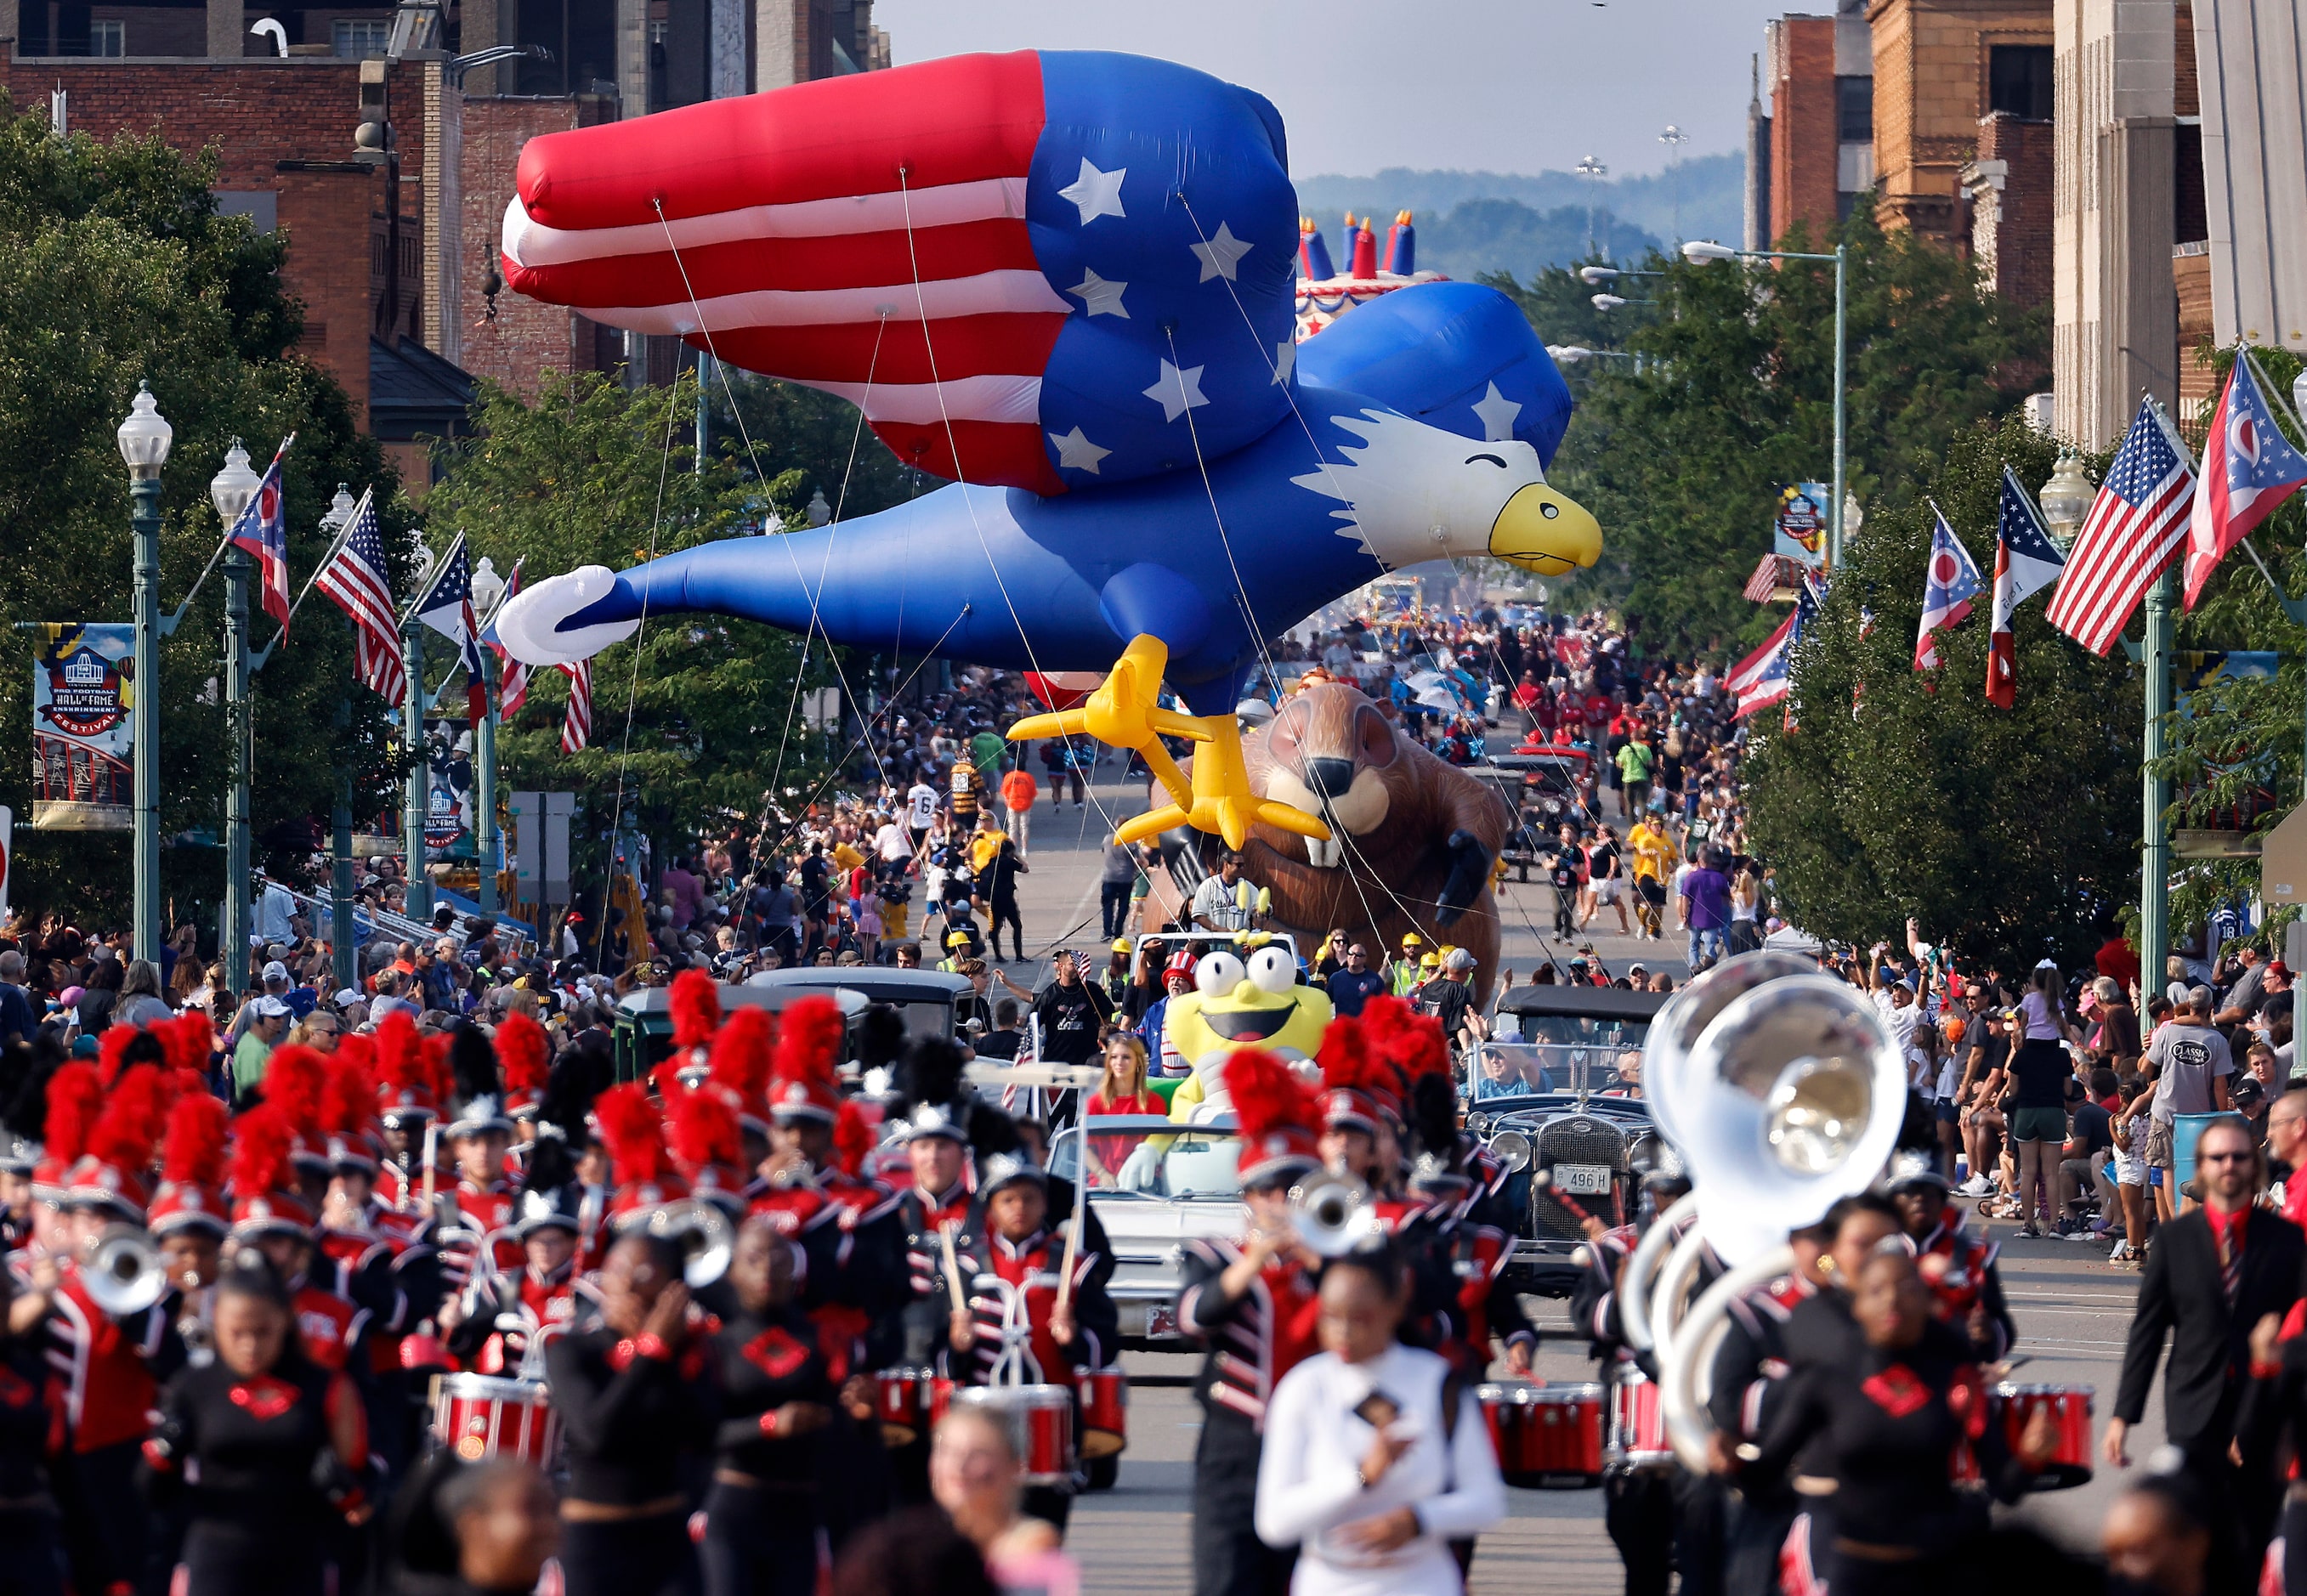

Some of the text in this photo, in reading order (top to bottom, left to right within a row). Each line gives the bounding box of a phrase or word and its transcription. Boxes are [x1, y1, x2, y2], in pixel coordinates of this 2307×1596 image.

[56, 694, 82, 705] HALL
[88, 694, 114, 705] FAME
[54, 713, 116, 733] FESTIVAL
[921, 796, 932, 814] 6
[2222, 925, 2235, 939] 18
[2173, 1044, 2208, 1058] CLASSIC
[1570, 1173, 1605, 1187] 496 H
